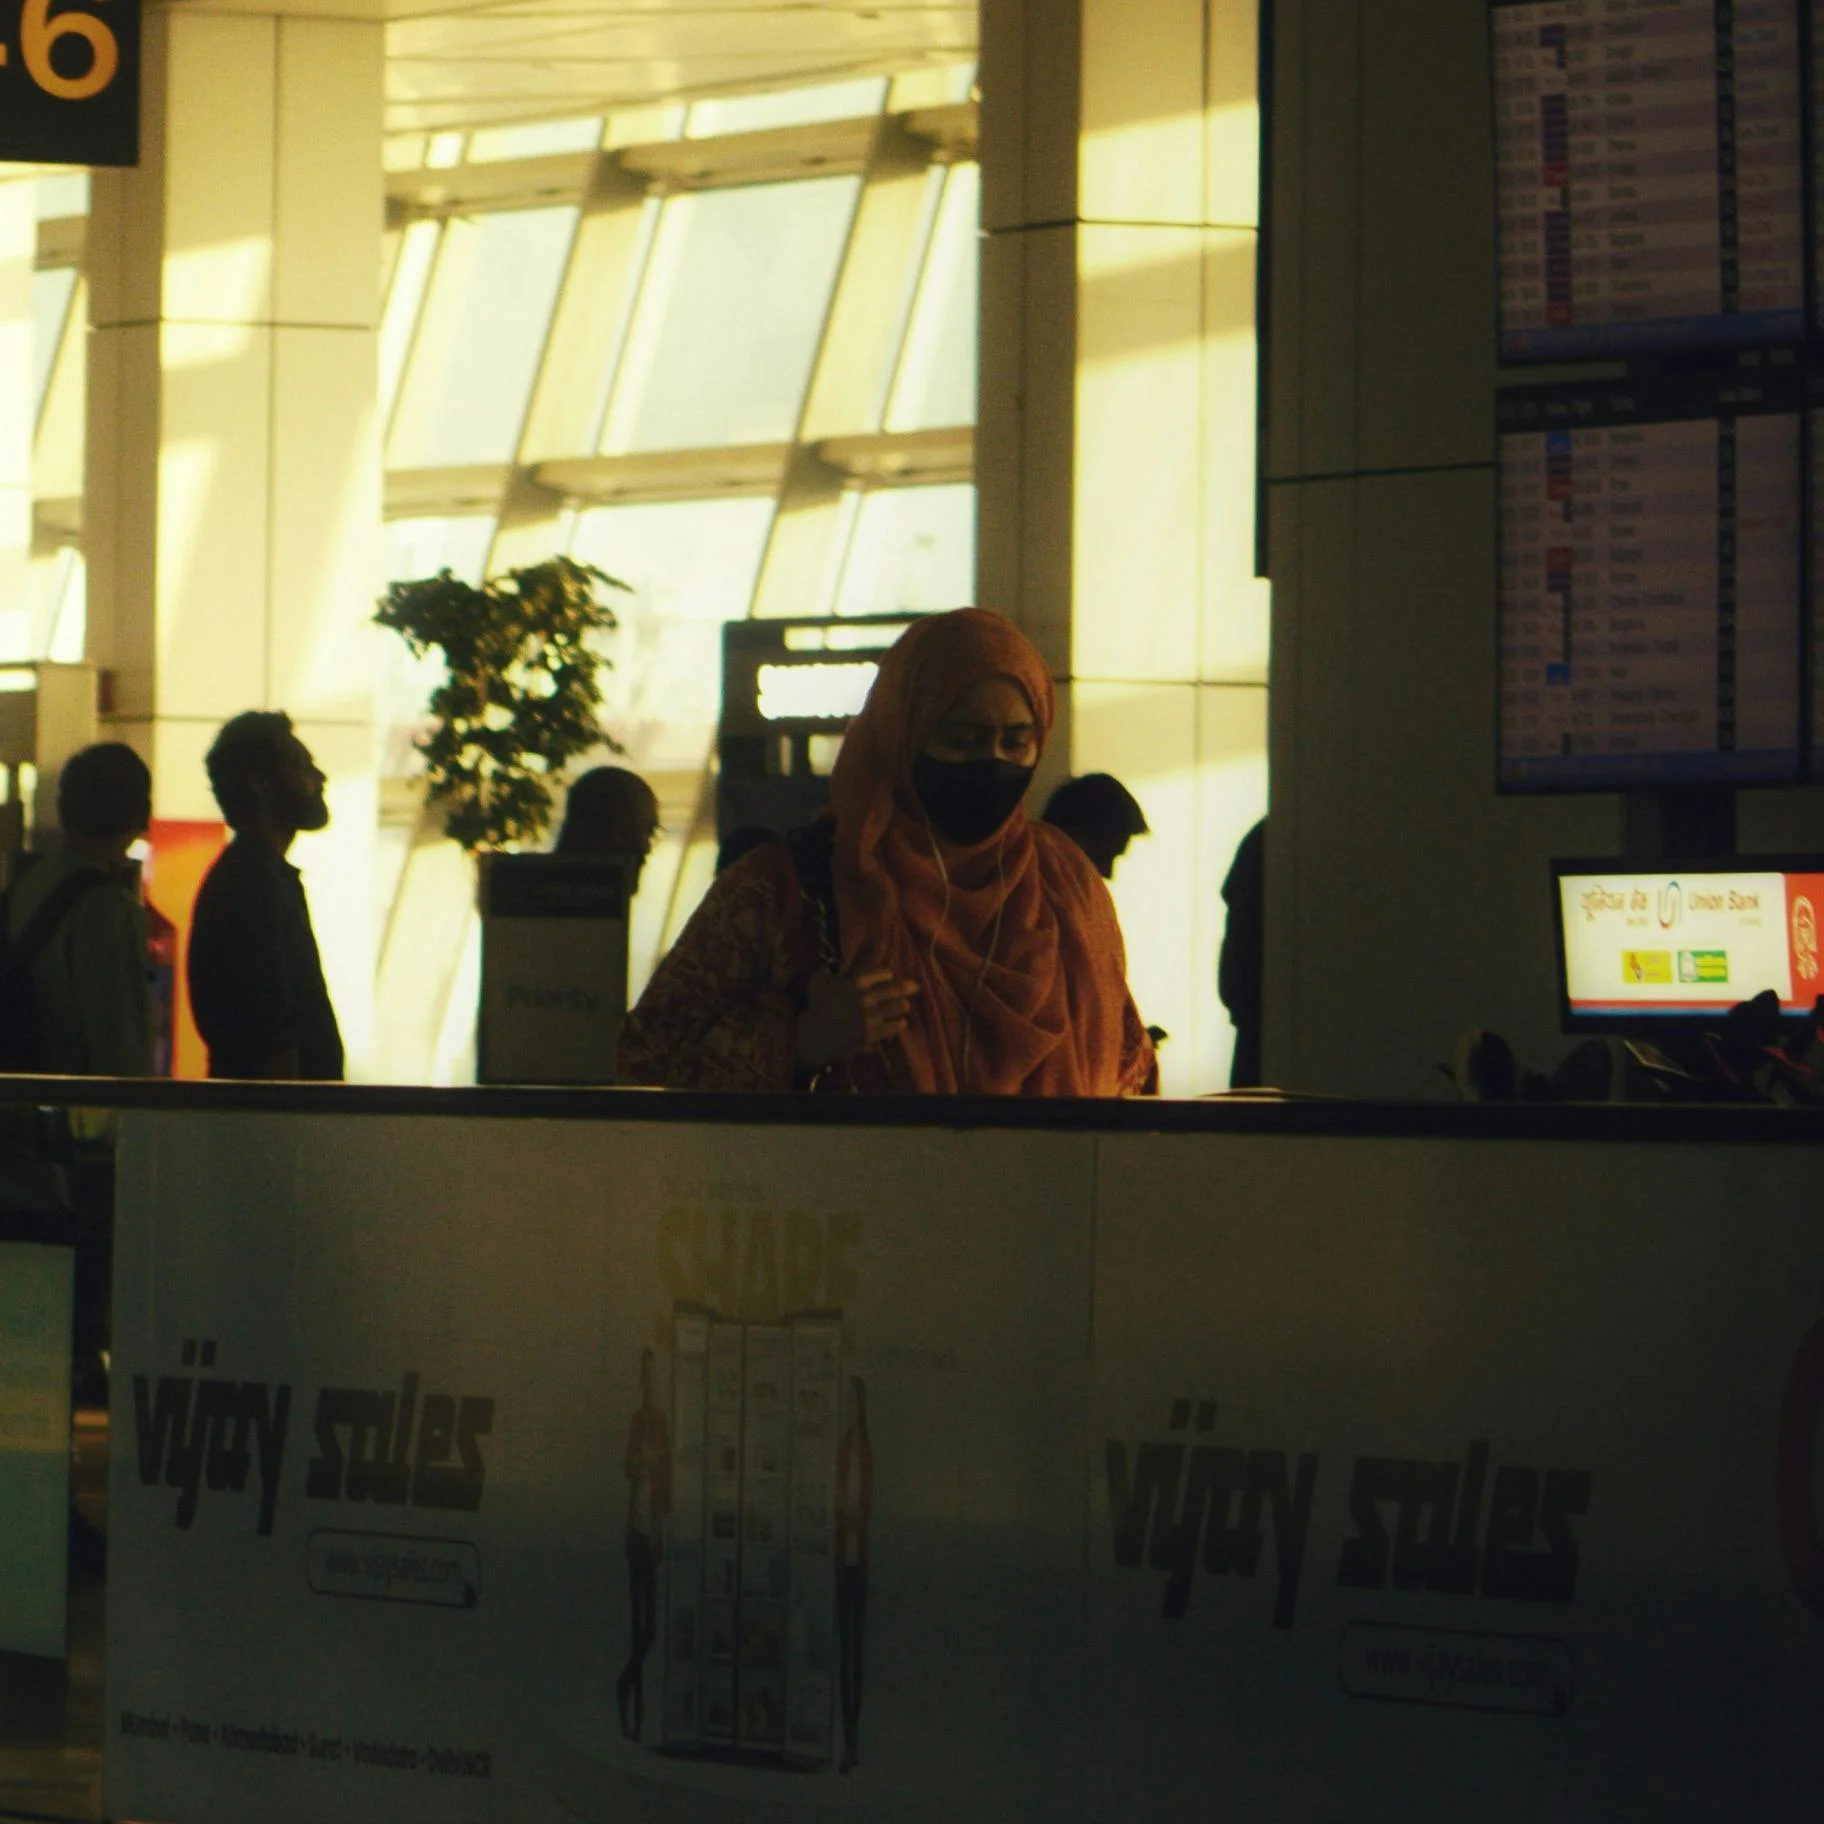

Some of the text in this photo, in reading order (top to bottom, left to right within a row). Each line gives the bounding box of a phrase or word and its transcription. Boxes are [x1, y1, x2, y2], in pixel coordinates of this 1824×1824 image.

[134, 1340, 495, 1535] vijay sales
[1106, 1399, 1591, 1629] vijay sales
